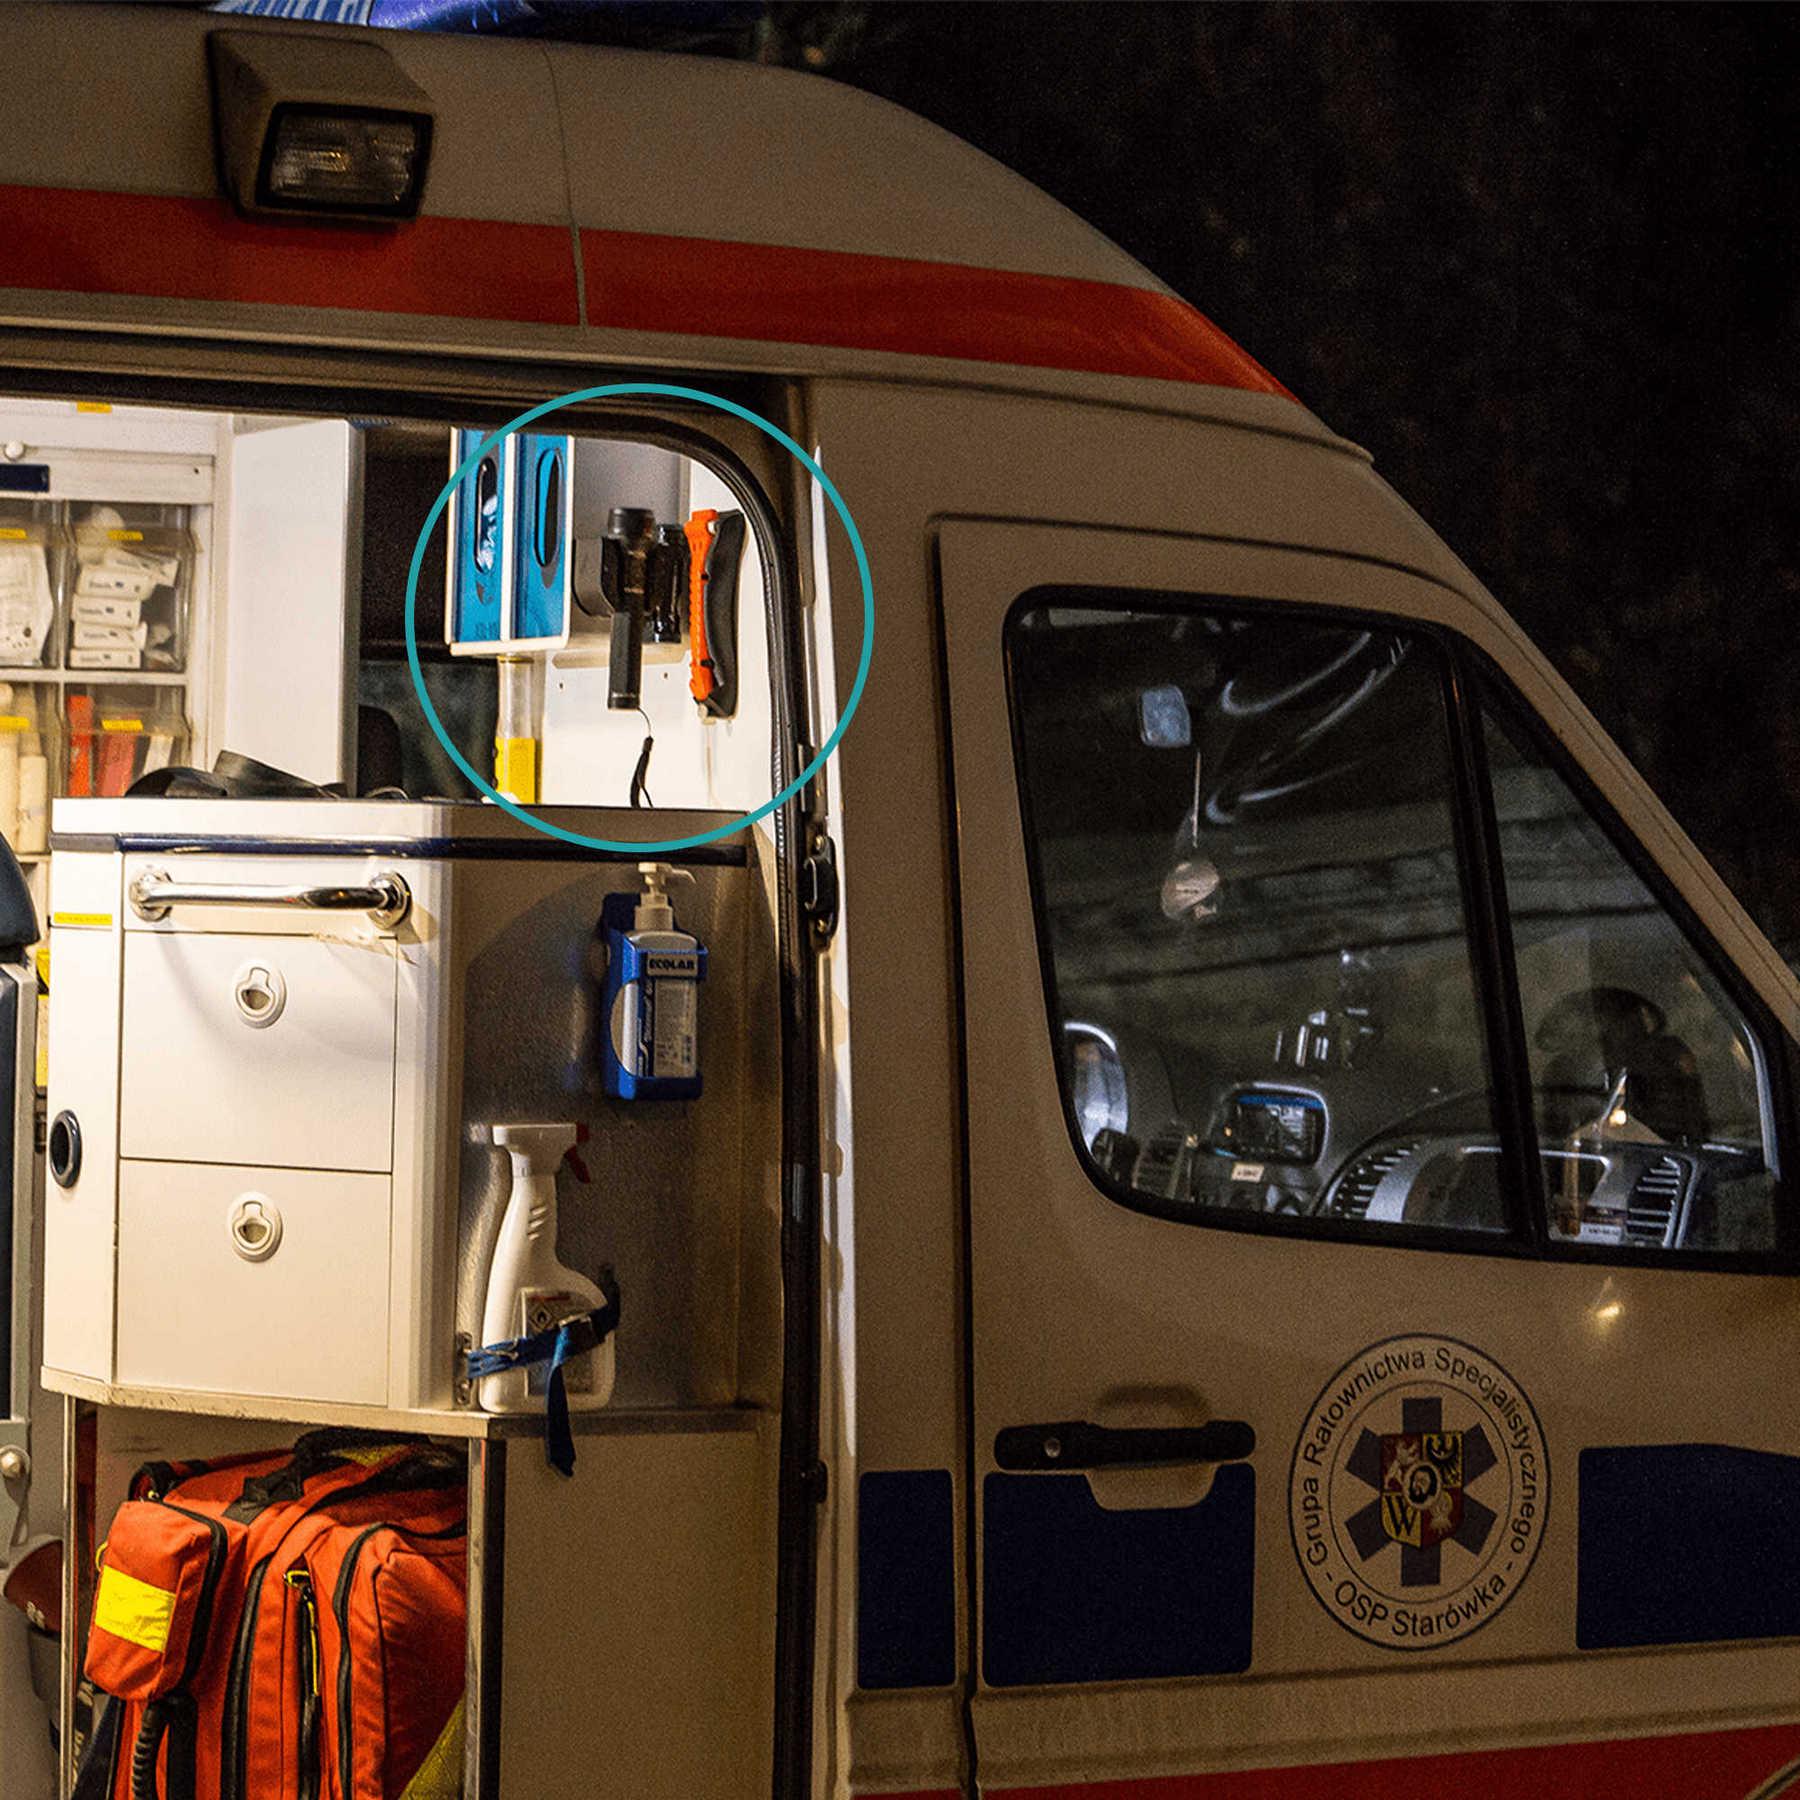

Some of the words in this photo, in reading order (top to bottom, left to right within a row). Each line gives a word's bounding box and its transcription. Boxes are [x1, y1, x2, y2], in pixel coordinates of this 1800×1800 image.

[1304, 1347, 1426, 1467] Ratownictwa
[1434, 1347, 1537, 1555] Specjalistycznego
[1303, 1480, 1328, 1566] Grupa
[1334, 1578, 1389, 1628] OSP
[1391, 1573, 1507, 1637] Starówka
